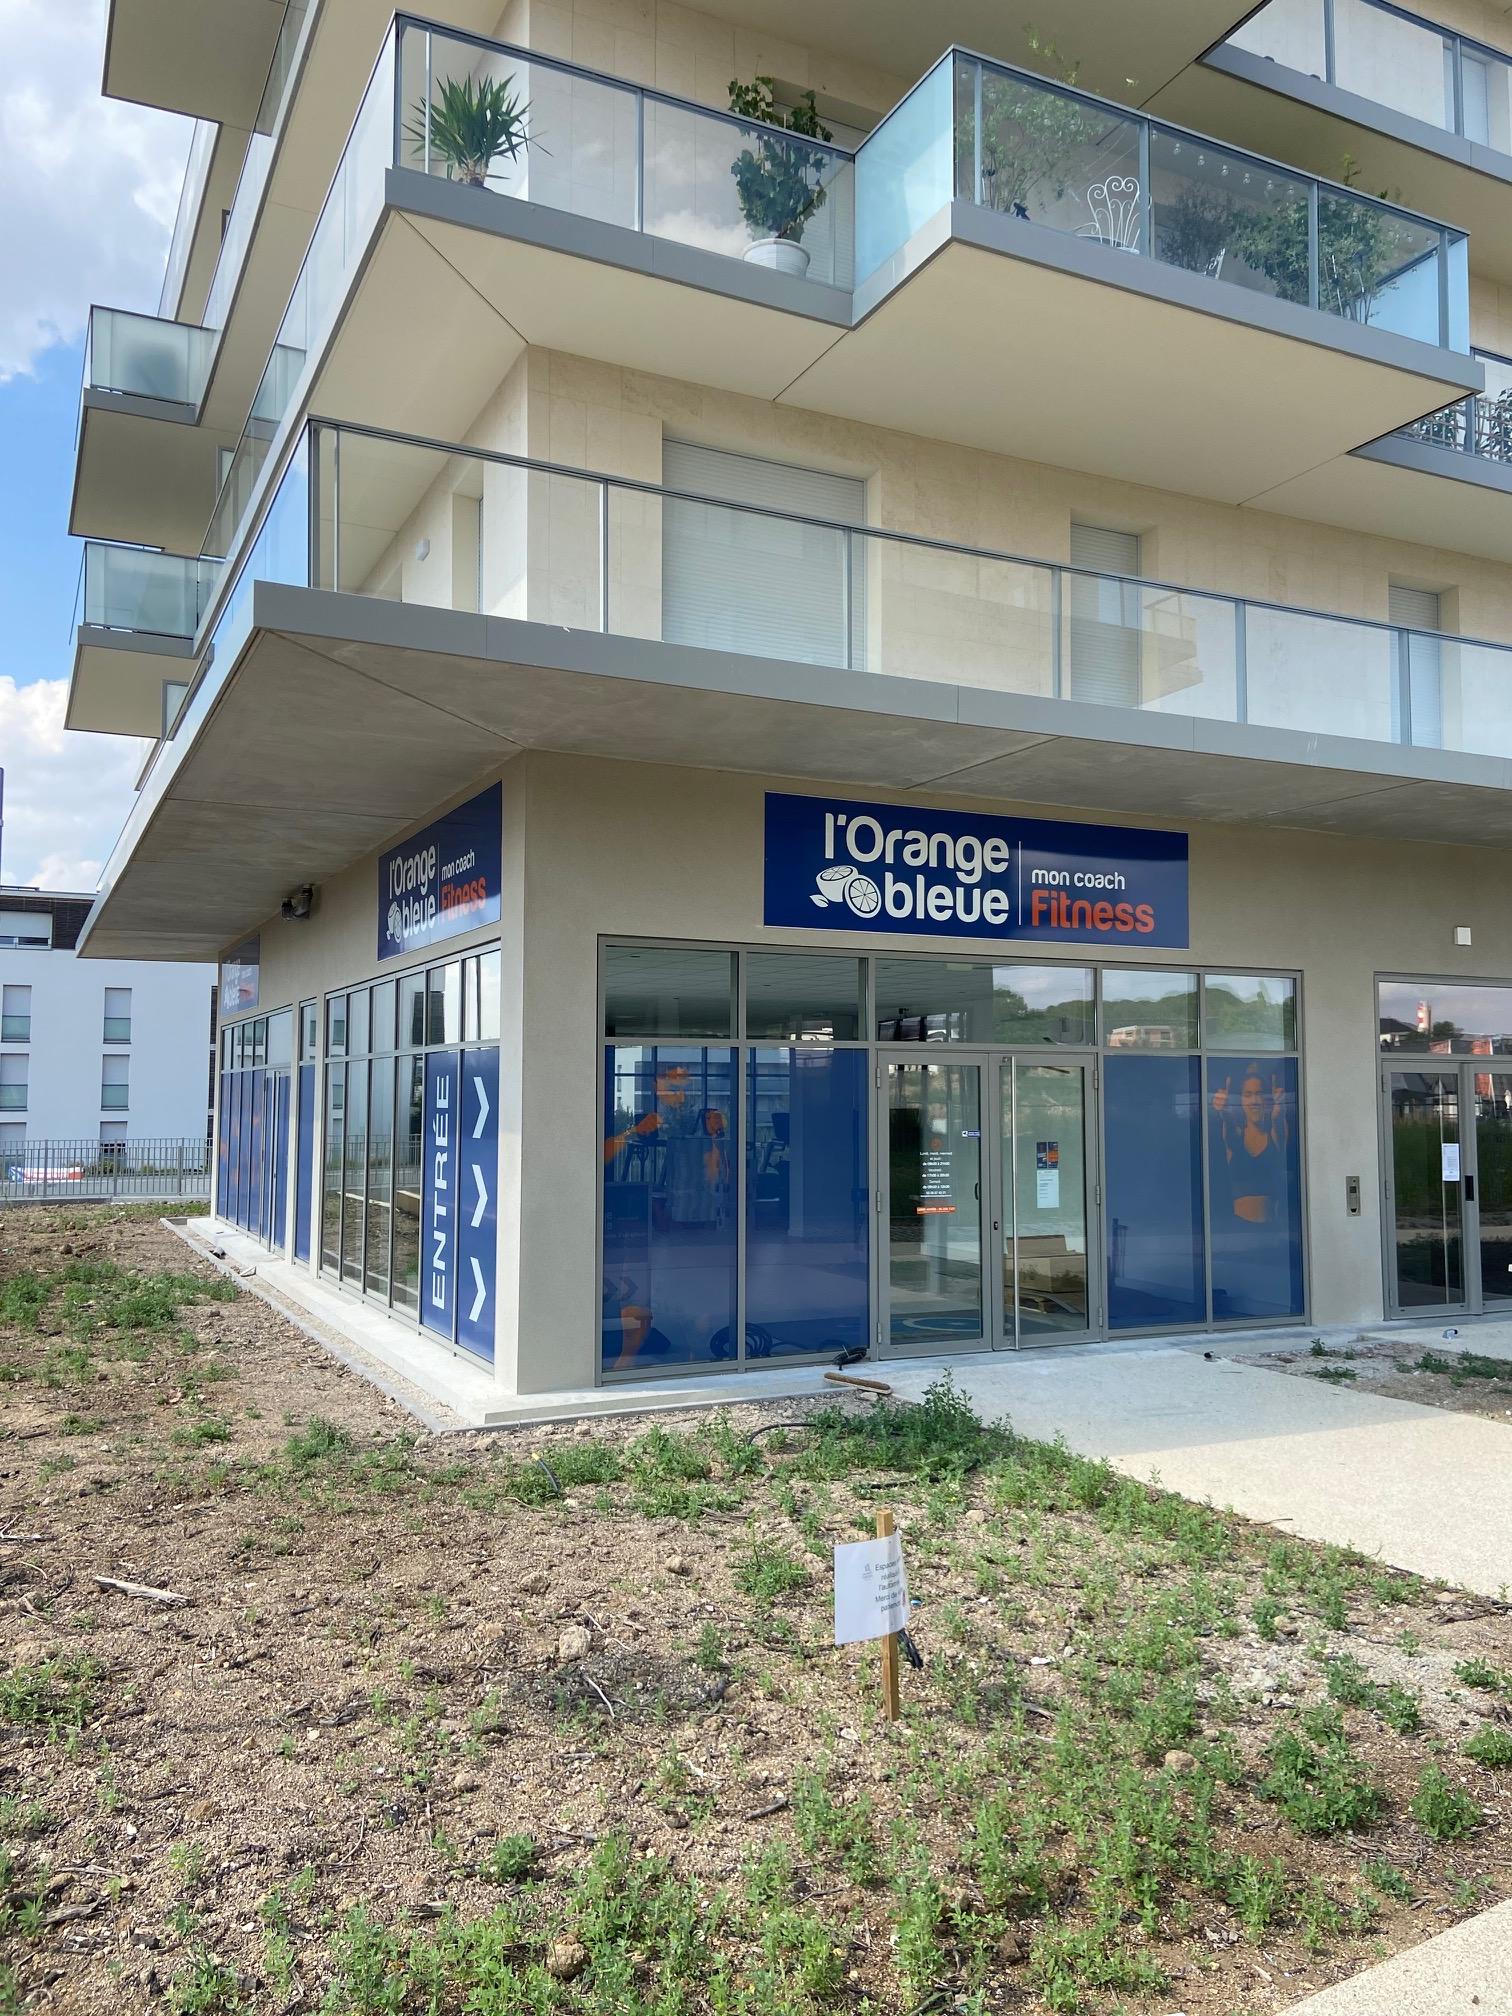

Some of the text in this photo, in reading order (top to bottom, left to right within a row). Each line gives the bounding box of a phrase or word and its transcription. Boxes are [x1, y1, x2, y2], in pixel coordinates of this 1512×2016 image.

[441, 848, 475, 882] mon coach
[824, 812, 1010, 884] l'Orange
[389, 845, 436, 900] l'Orange
[1031, 869, 1126, 891] mon coach
[402, 894, 437, 939] bleue
[441, 876, 487, 923] Fitness
[884, 871, 1010, 925] bleue
[1031, 889, 1155, 934] Fitness
[432, 1075, 450, 1311] ENTRÉE
